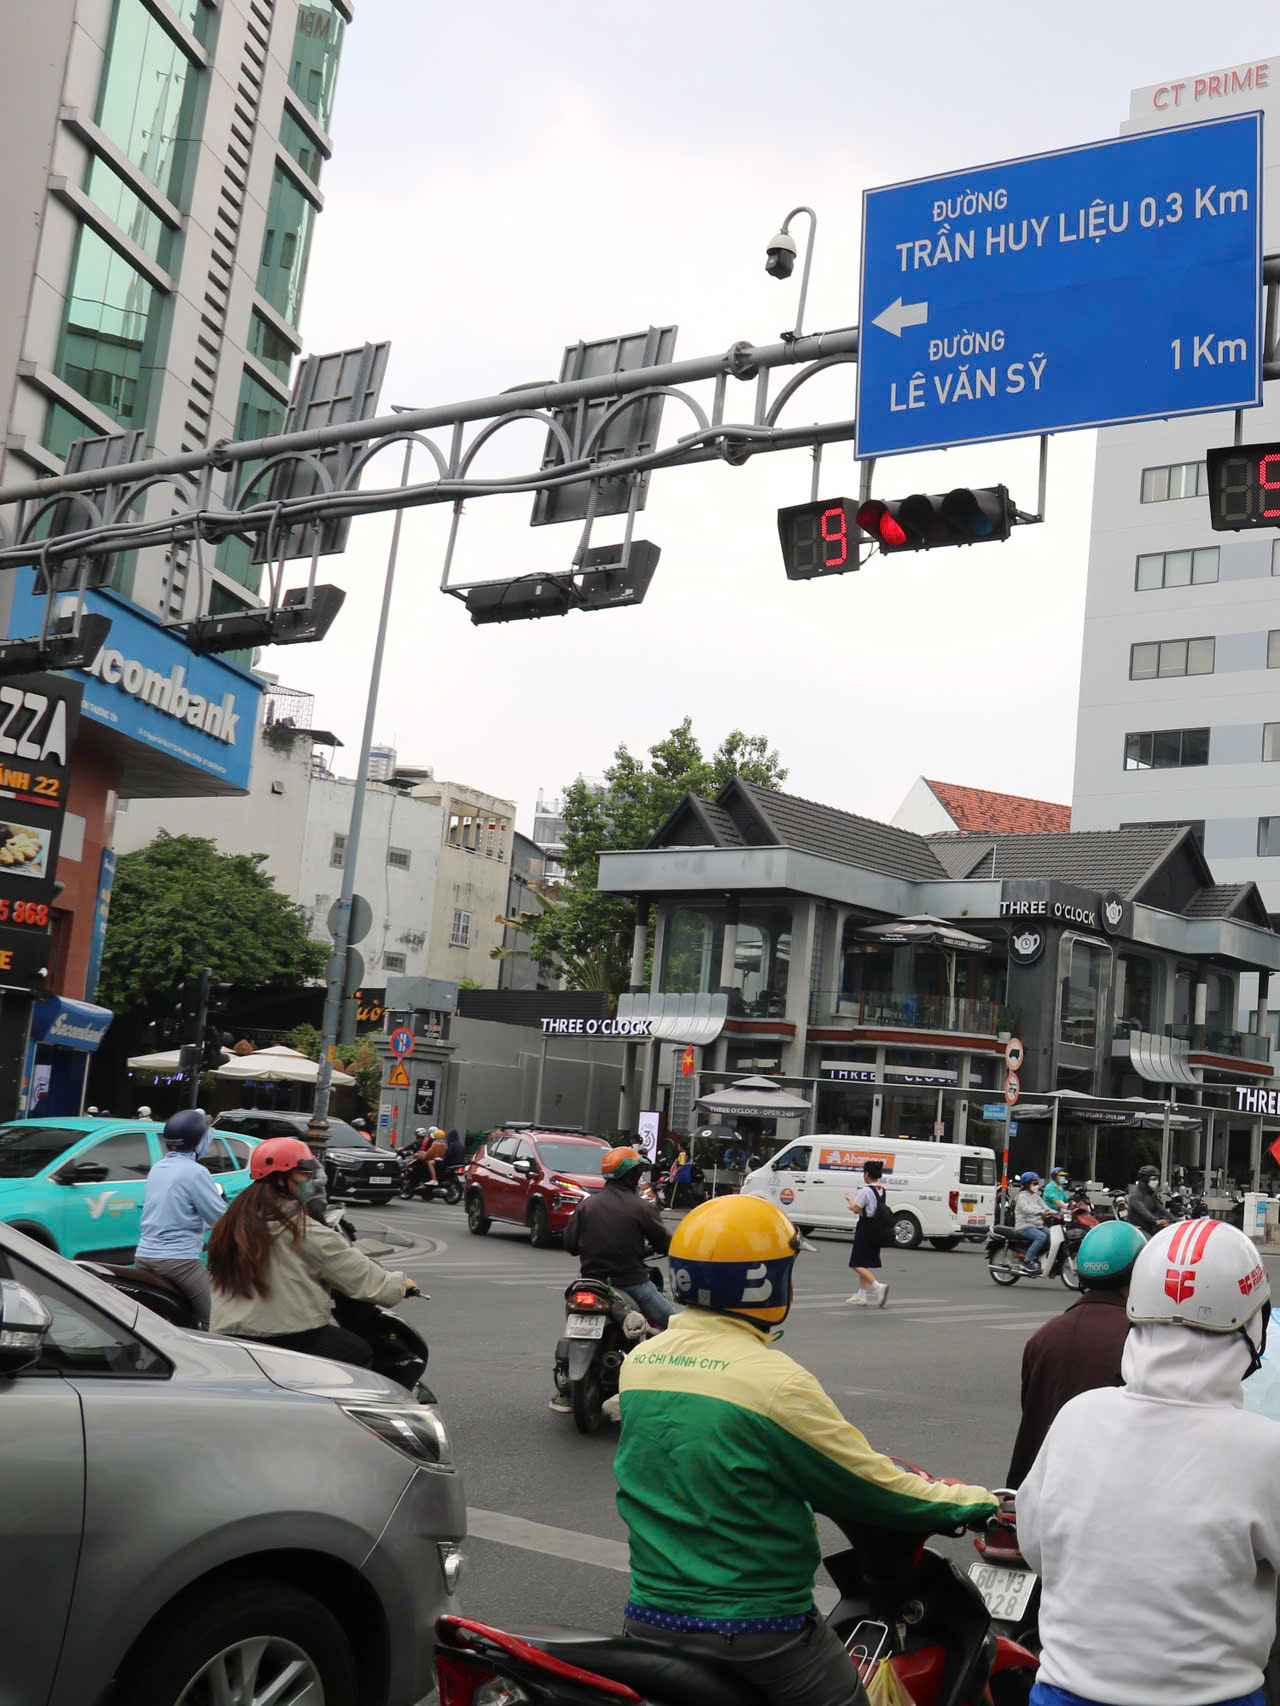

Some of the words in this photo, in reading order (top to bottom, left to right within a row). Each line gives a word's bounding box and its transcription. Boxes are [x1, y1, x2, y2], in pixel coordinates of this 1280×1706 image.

[1153, 83, 1185, 109] CT
[1194, 64, 1269, 100] PRIME
[932, 189, 1008, 222] ĐƯỜNG
[896, 222, 975, 272] TRẦN
[986, 216, 1050, 256] HUY
[1058, 198, 1128, 243] LIỆU
[1140, 192, 1183, 229] 0,3
[1195, 185, 1249, 219] Km
[929, 329, 1005, 361] ĐƯỜNG
[890, 371, 925, 412] LÊ
[934, 365, 996, 404] VĂN
[1006, 352, 1048, 394] SỸ
[1170, 338, 1181, 370] 1
[1193, 334, 1248, 368] Km
[821, 507, 847, 567] 9
[84, 646, 240, 745] combank
[33, 776, 61, 797] 22
[13, 901, 50, 926] 868
[1001, 900, 1047, 915] THREE
[1054, 903, 1096, 926] O'CLOCK
[540, 1018, 584, 1033] THREE
[586, 1019, 651, 1035] O'CLOCK
[710, 1106, 730, 1114] THREE
[731, 1107, 758, 1116] O'CLOCK
[762, 1109, 781, 1117] OPEN
[633, 1354, 646, 1364] HO
[649, 1354, 666, 1364] CHI
[668, 1355, 697, 1367] MINH
[700, 1358, 729, 1372] CITY
[976, 1567, 1026, 1593] 60-V3
